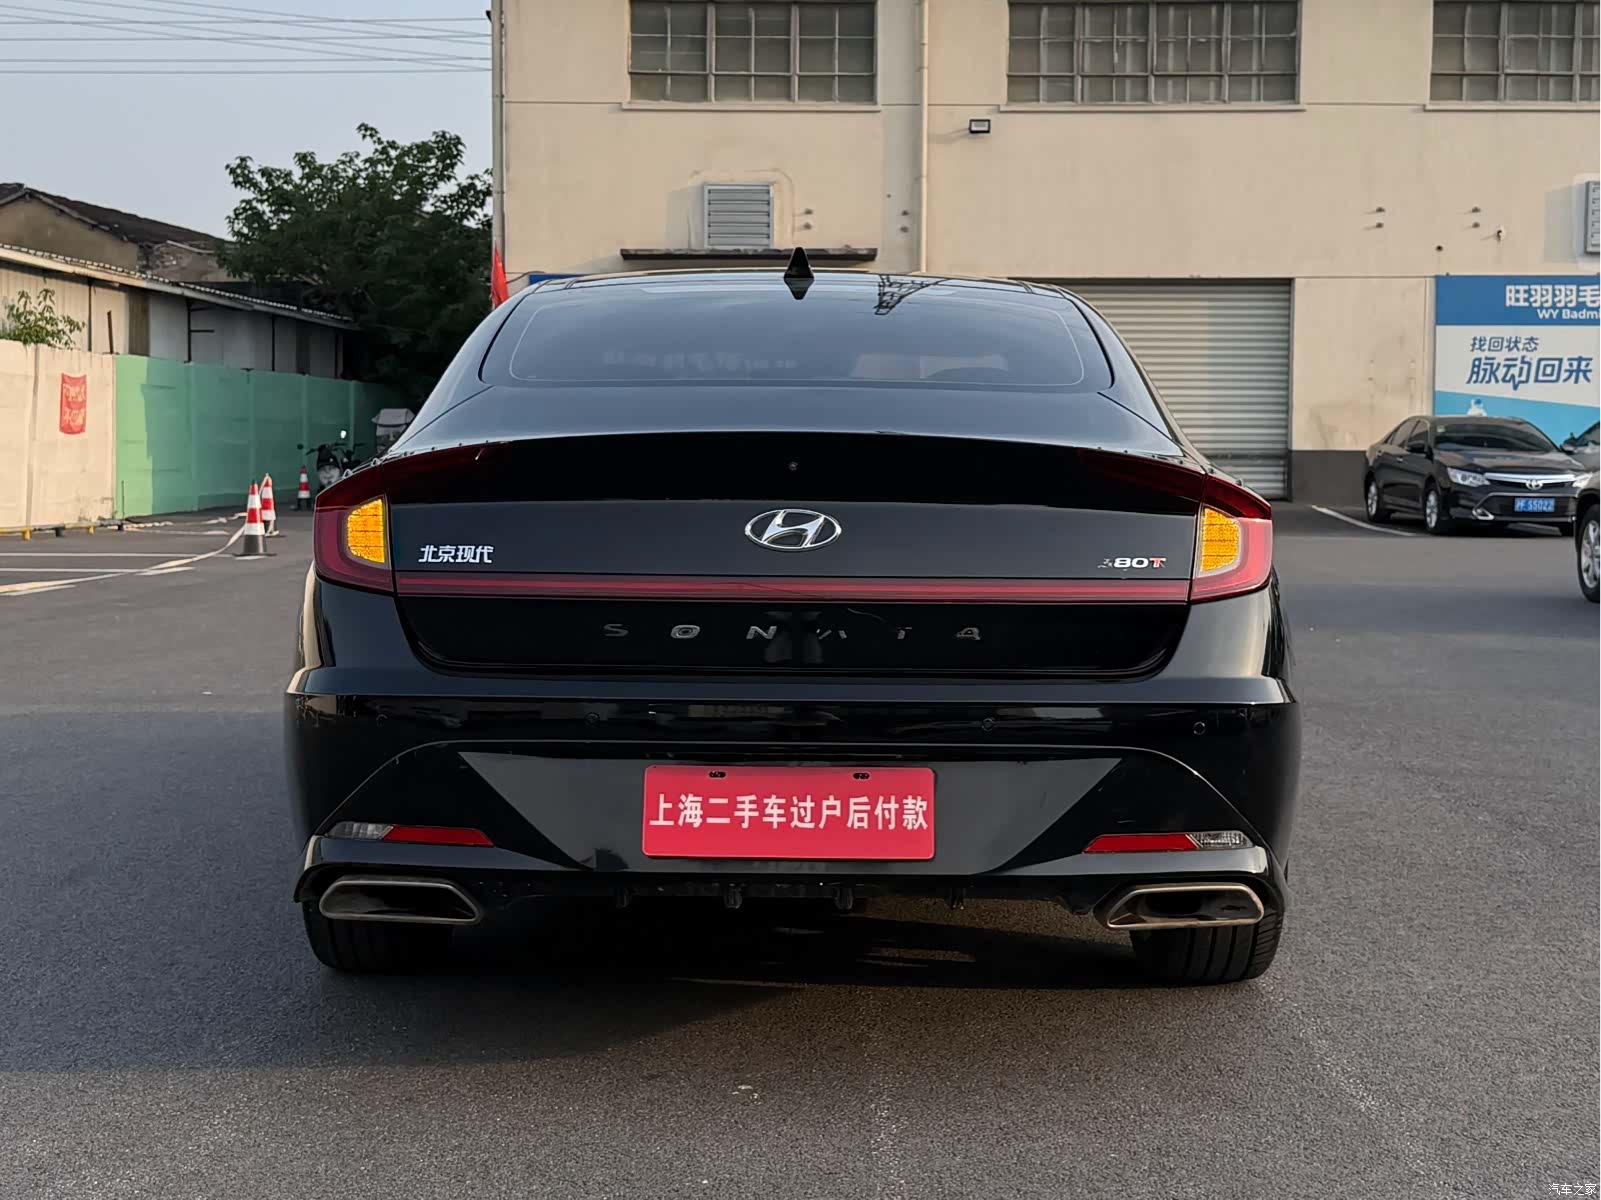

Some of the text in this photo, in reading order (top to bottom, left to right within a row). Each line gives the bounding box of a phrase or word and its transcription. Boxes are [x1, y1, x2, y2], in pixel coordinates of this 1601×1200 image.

[1537, 308, 1560, 319] WY
[1470, 336, 1540, 352] 找回状态
[1466, 355, 1594, 391] 脉动回来
[418, 544, 495, 564] 北京现代
[649, 793, 929, 831] 上海二手车过户后付款
